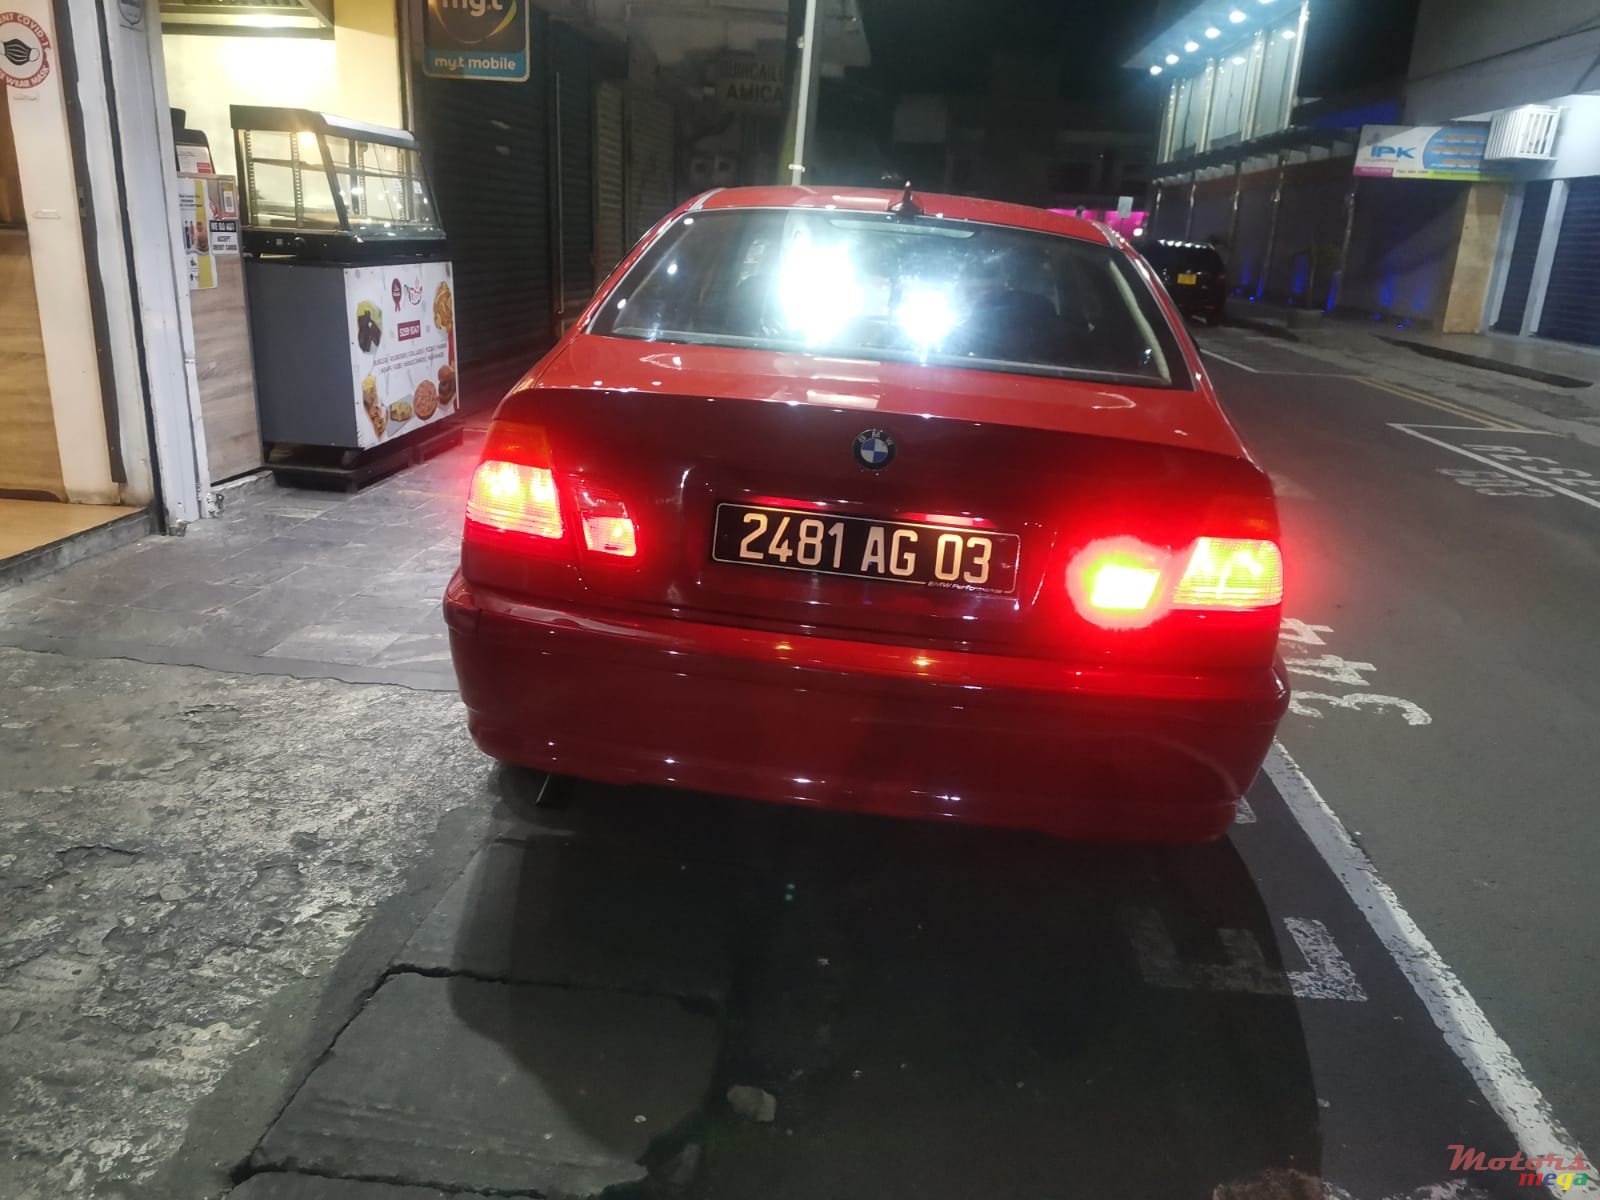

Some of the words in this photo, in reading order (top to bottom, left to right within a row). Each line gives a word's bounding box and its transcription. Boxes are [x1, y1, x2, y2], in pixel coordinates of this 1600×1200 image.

[468, 57, 517, 71] mobile
[739, 512, 845, 570] 2481
[860, 526, 919, 577] AG
[934, 534, 993, 584] 03
